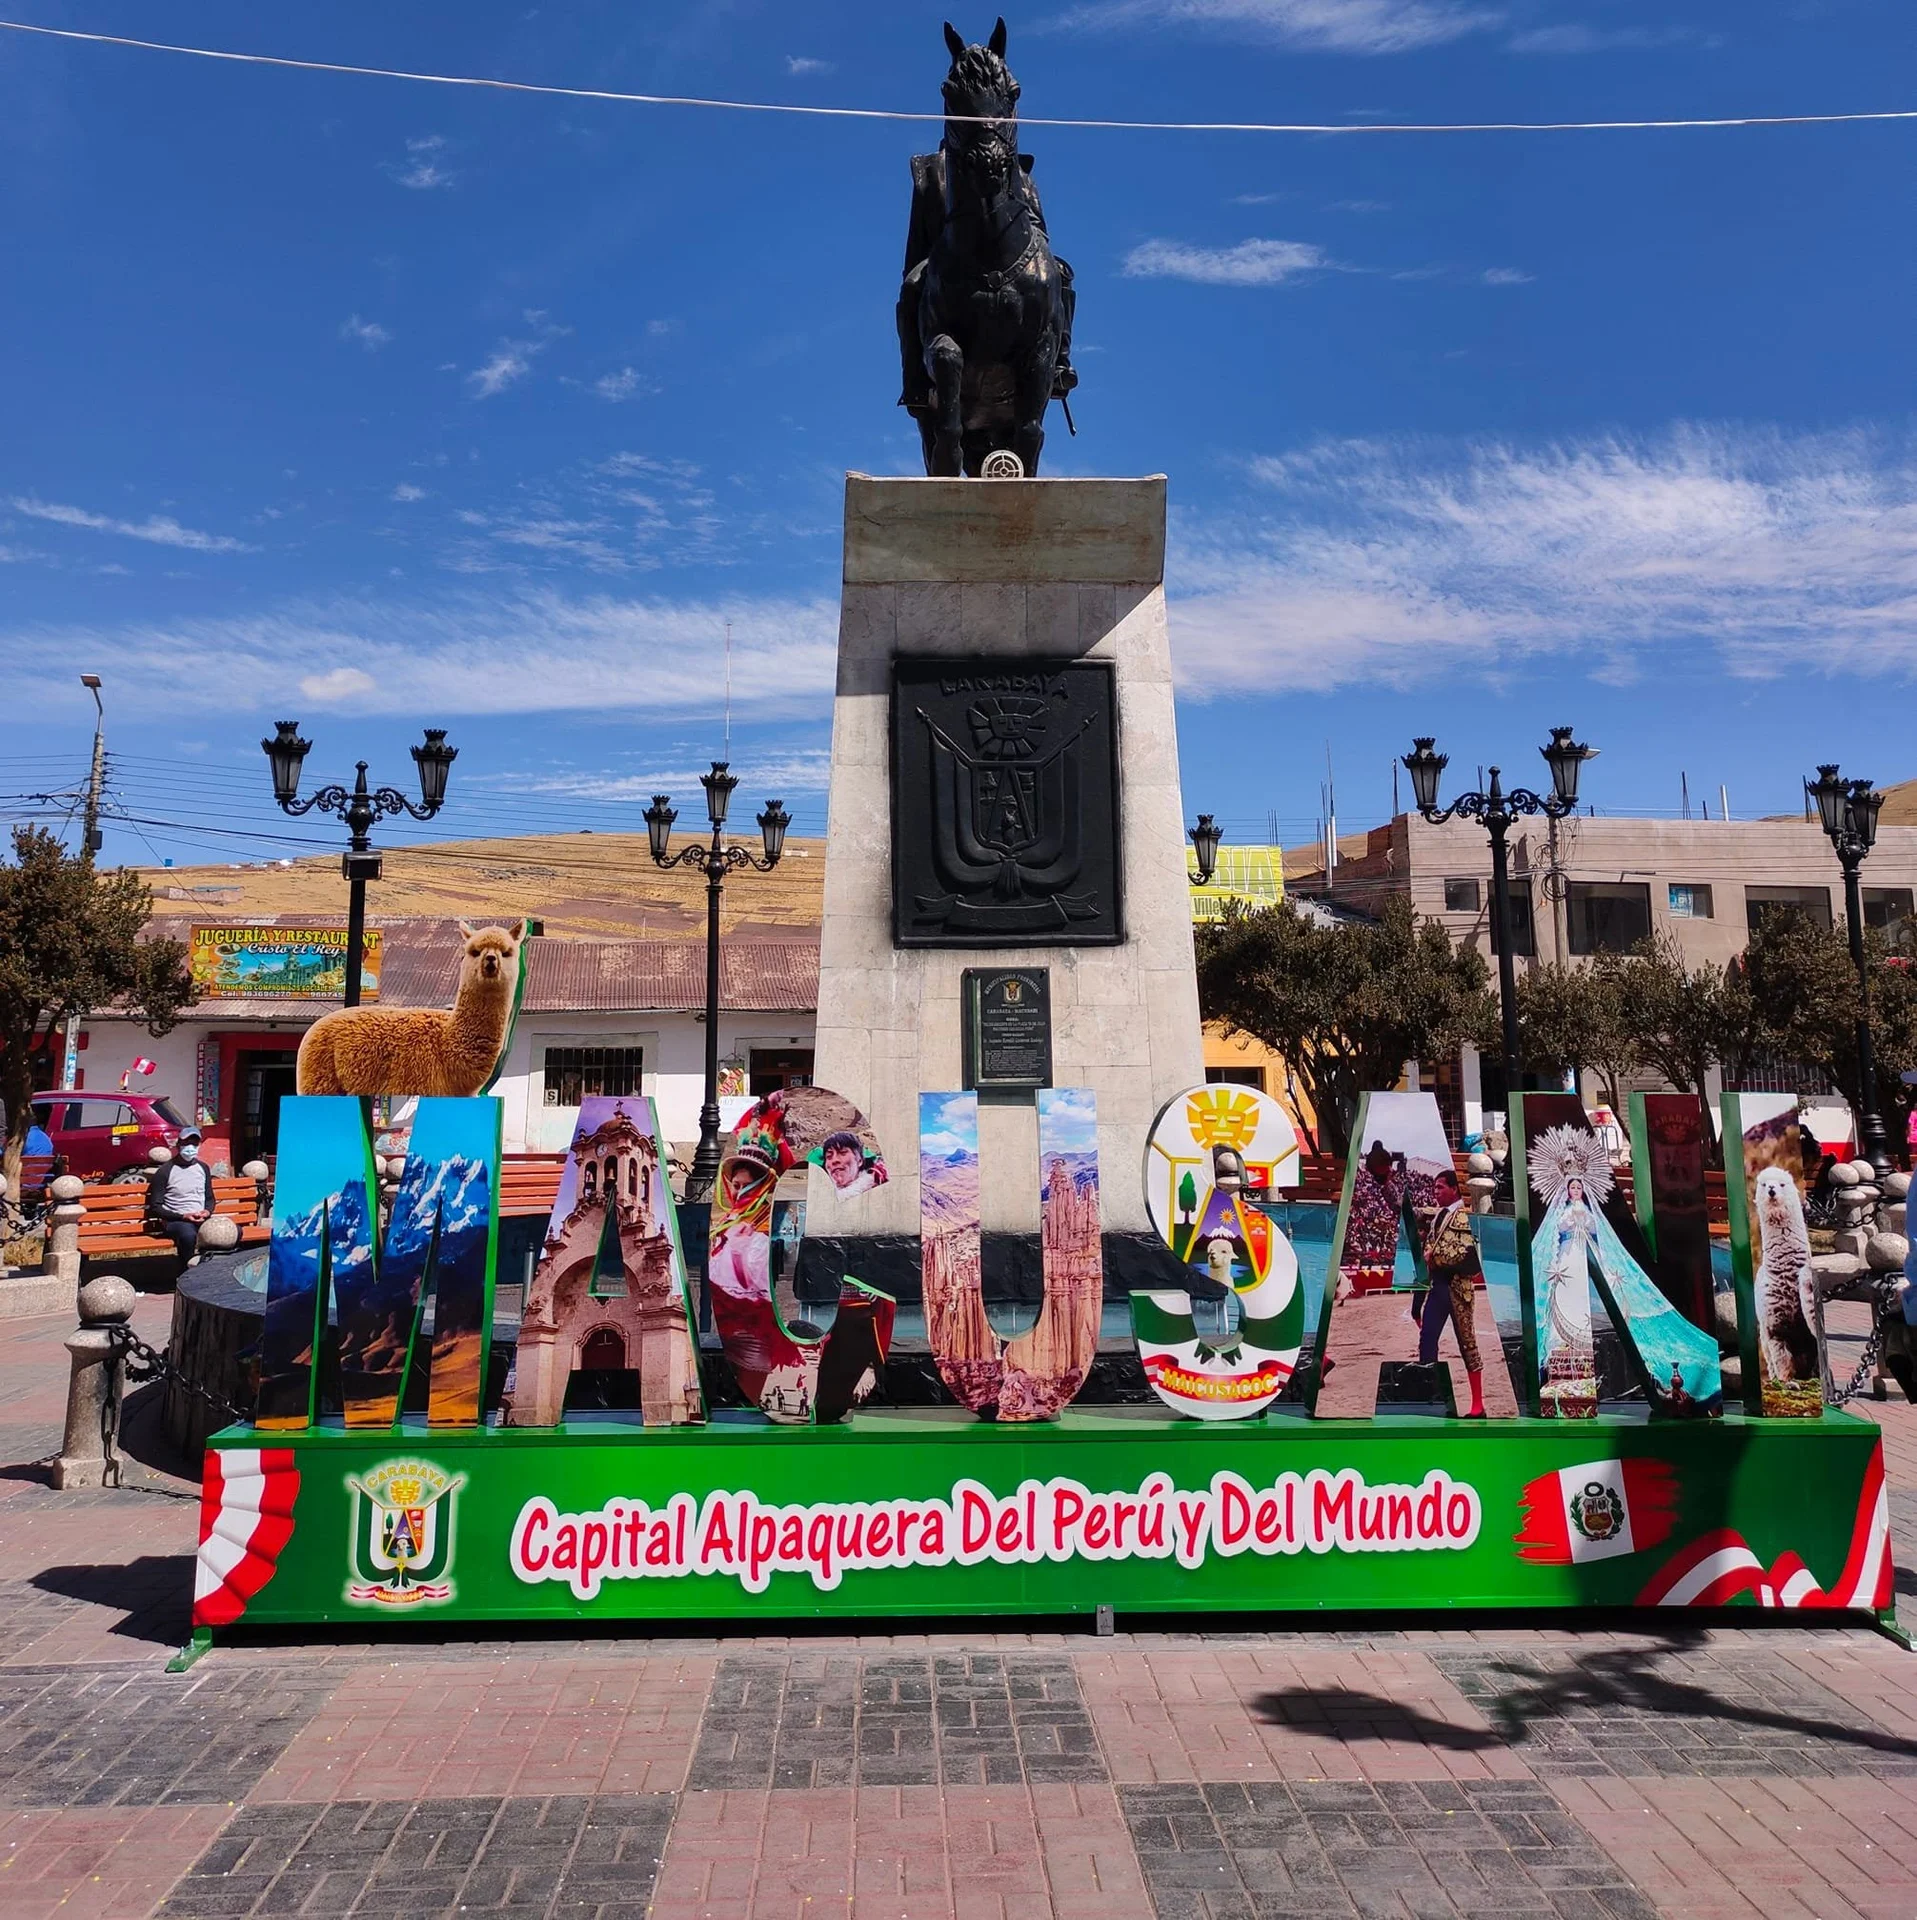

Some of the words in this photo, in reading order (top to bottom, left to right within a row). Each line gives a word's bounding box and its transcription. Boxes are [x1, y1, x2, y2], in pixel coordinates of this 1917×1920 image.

[195, 926, 268, 946] JUGUERÍA
[270, 930, 282, 943] Y
[286, 930, 379, 949] RESTAURNT
[247, 943, 289, 955] Cristo
[290, 943, 306, 954] El
[310, 943, 341, 958] Rey
[547, 1090, 556, 1101] S
[366, 1464, 446, 1490] CARABAYA
[519, 1499, 688, 1590] Capital
[700, 1498, 946, 1583] Alpaquera
[960, 1486, 1036, 1556] Del
[1052, 1481, 1165, 1551] Perú
[1178, 1499, 1207, 1559] y
[1219, 1478, 1295, 1546] Del
[1312, 1476, 1472, 1543] Mundo
